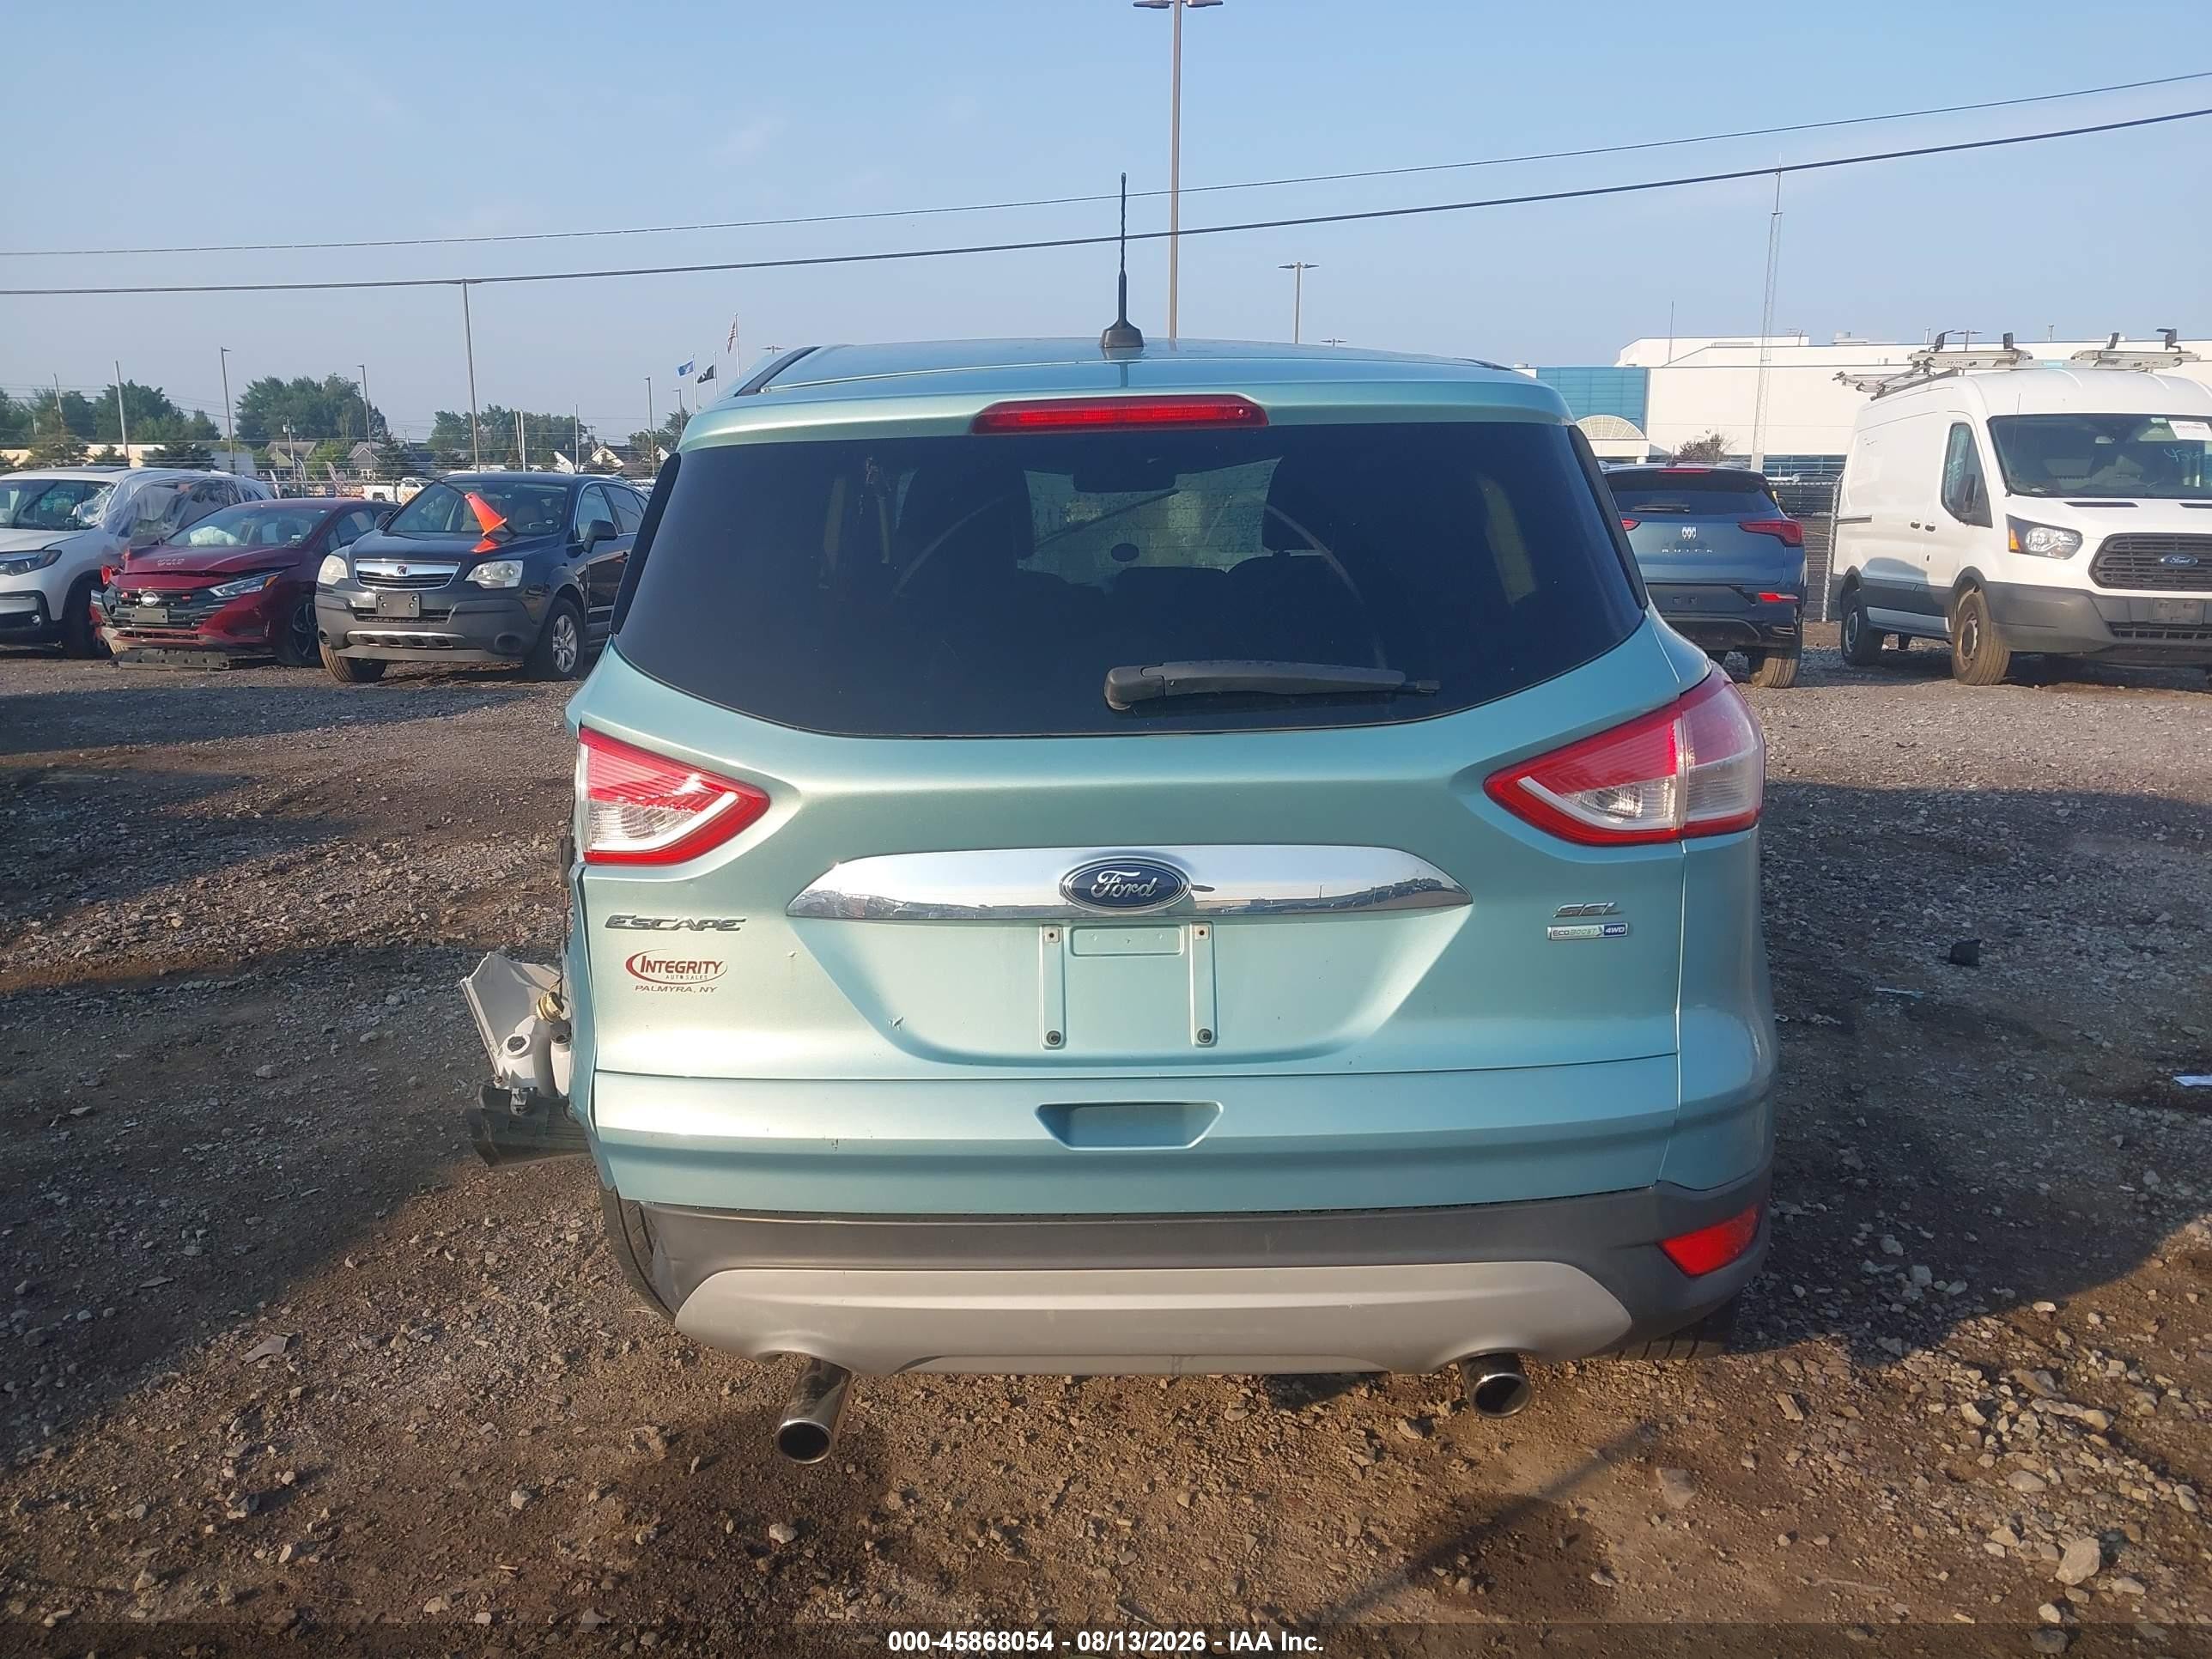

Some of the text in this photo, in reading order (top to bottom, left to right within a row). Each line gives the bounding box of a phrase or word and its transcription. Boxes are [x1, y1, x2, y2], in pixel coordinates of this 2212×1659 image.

[1091, 870, 1158, 898] Ford
[605, 915, 747, 932] ESCAPE
[640, 955, 725, 975] INTEGRITY
[635, 985, 696, 994] PALMYRA,
